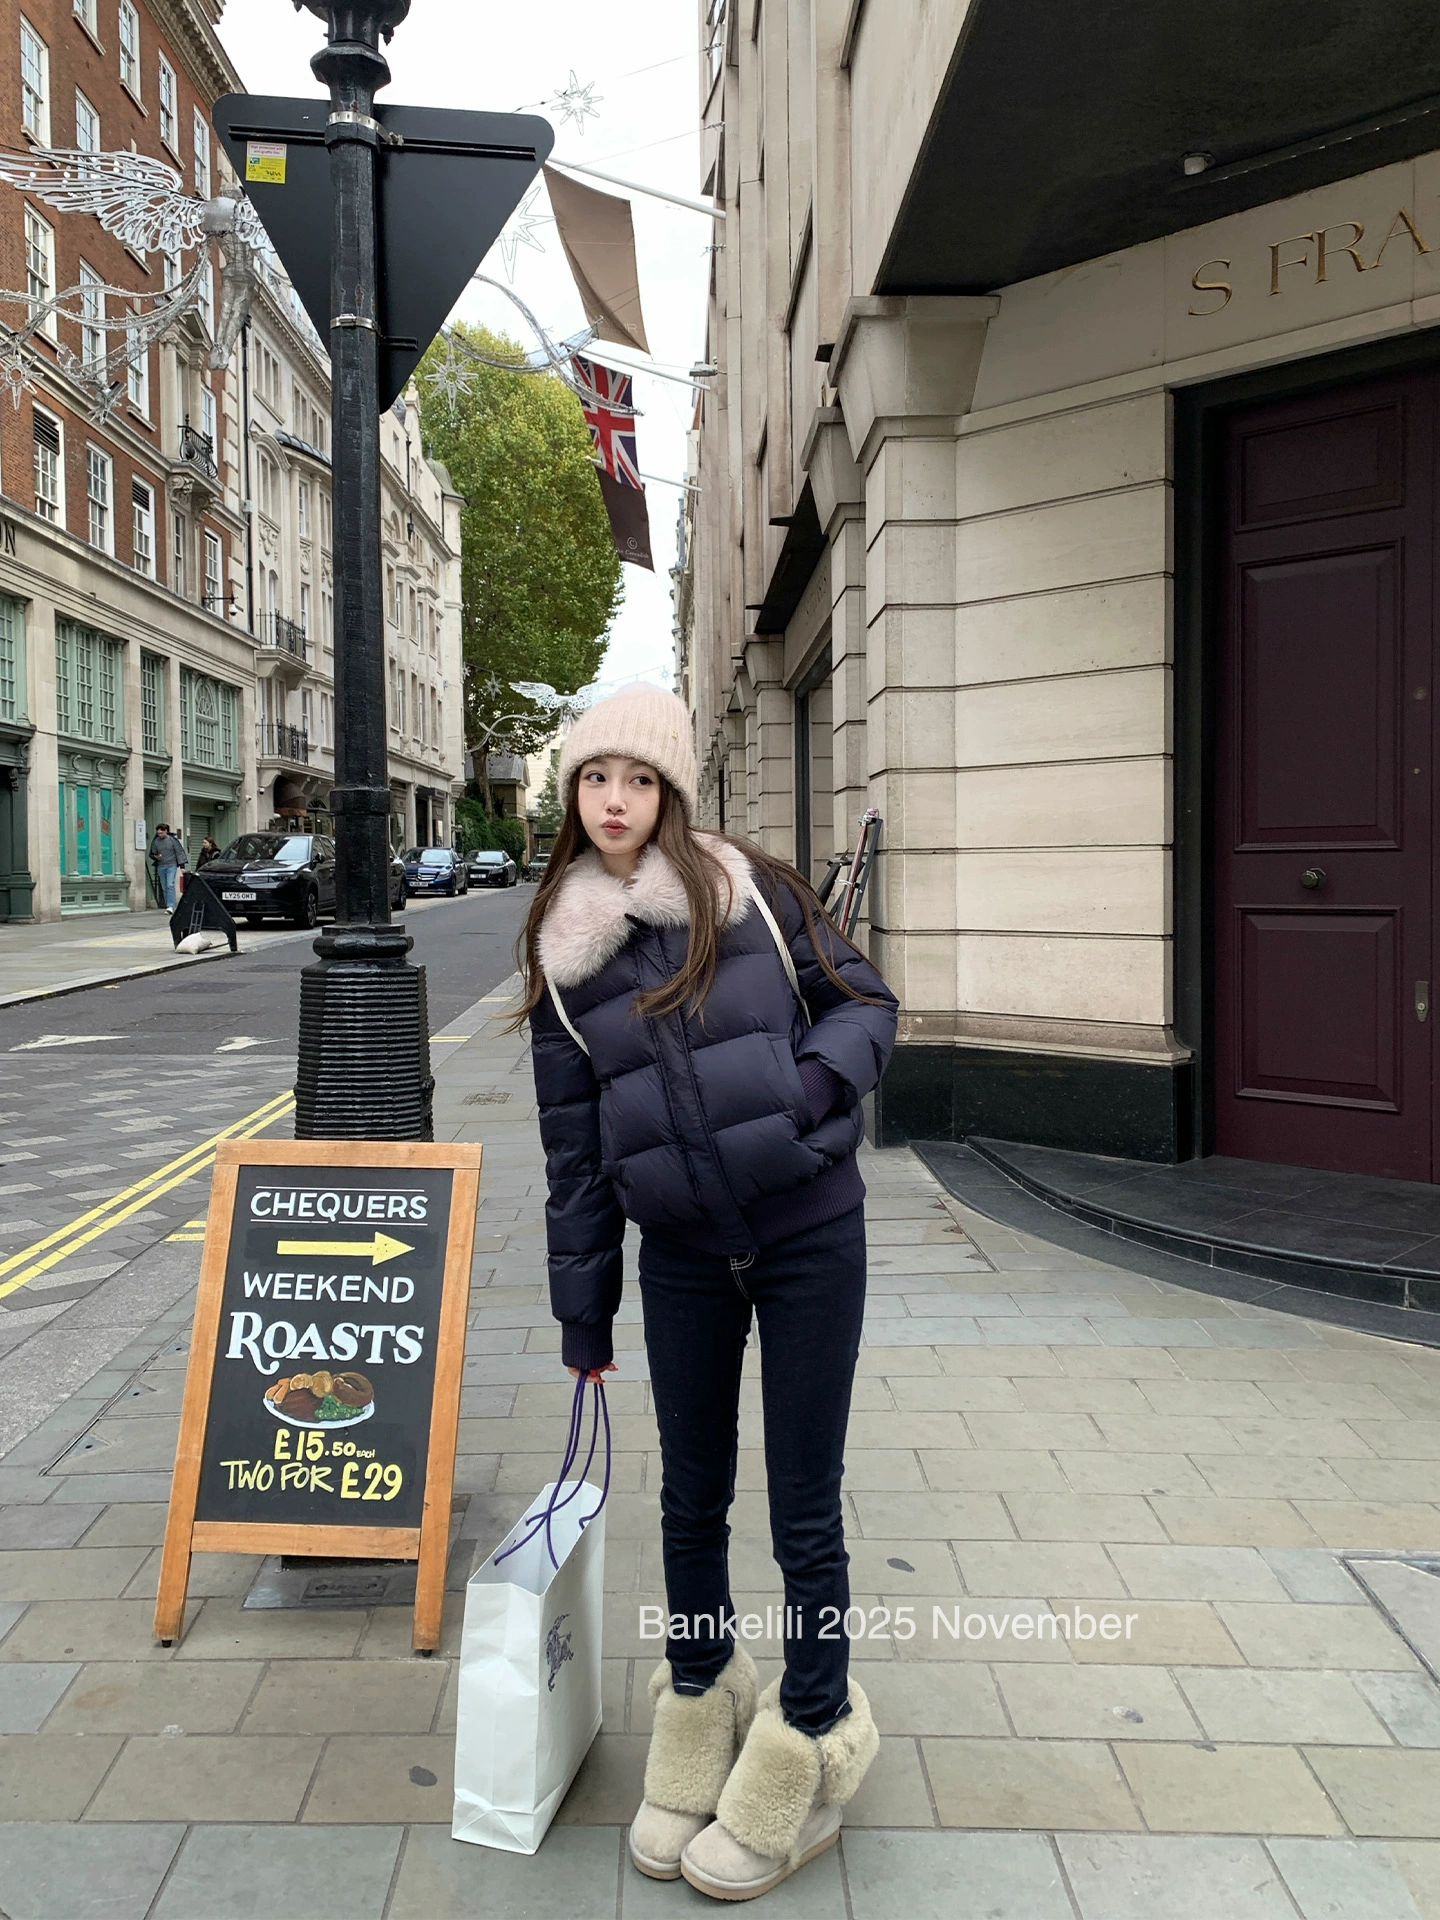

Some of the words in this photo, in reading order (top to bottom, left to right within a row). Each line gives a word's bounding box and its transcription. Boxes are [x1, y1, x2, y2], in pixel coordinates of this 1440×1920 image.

[1188, 258, 1233, 316] S
[1267, 206, 1440, 296] FRA
[250, 1191, 429, 1222] CHEQUERS
[243, 1271, 415, 1304] WEEKEND
[225, 1311, 425, 1376] ROASTS
[274, 1428, 357, 1461] £15.50
[219, 1459, 275, 1492] TWO
[280, 1462, 335, 1493] FOR
[340, 1461, 403, 1502] £29
